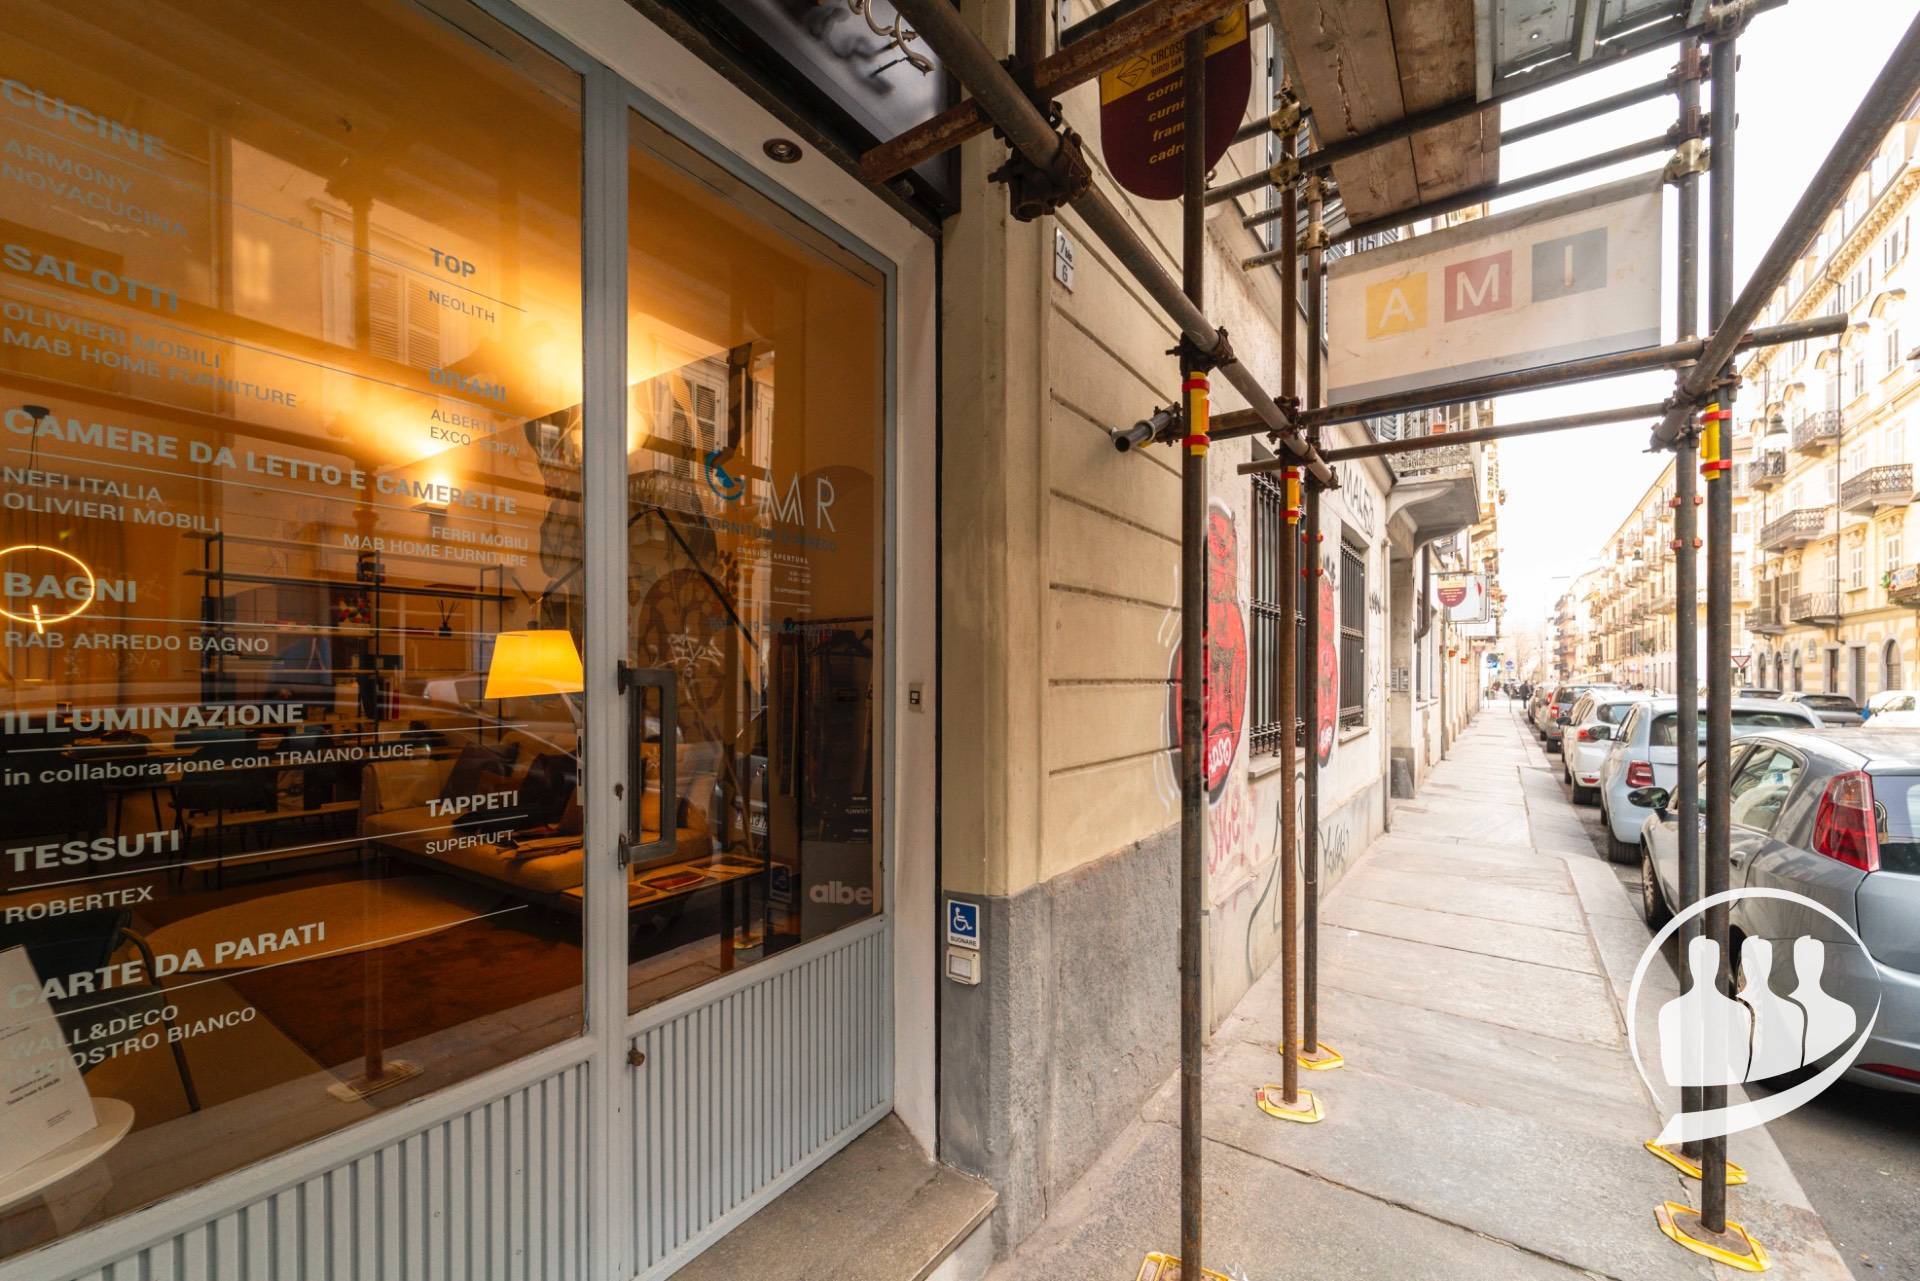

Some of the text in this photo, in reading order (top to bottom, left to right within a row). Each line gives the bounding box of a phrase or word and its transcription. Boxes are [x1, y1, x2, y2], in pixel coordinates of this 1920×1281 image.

[1148, 76, 1184, 101] corni
[3, 79, 166, 161] CUCINE
[1149, 99, 1185, 122] curni
[1152, 122, 1185, 143] fram
[4, 139, 136, 195] ARMONY
[1149, 143, 1185, 165] cadr
[2, 162, 188, 237] NOVACUCINA
[3, 244, 179, 313] SALOTTI
[430, 247, 476, 278] TOP
[429, 290, 495, 323] NEOLITH
[3, 303, 220, 369] OLIVIERI MOBILI
[3, 327, 297, 408] MAB HOME FURNITURE
[4, 408, 517, 515] CAMERE DA LETTO E CAMERETTE
[2, 466, 163, 503] NEFI ITALIA
[3, 492, 220, 532] OLIVIERI MOBILI
[343, 533, 528, 568] MAB HOME FURNITURE
[432, 526, 529, 550] FERRI MOBILI
[3, 572, 137, 603] BAGNI
[5, 631, 269, 653] RAB ARREDO BAGNO
[4, 704, 304, 735] ILLUMINAZIONE
[5, 744, 414, 786] in collaborazione con TRAIANO LUCE
[426, 790, 518, 818] TAPPETI
[6, 829, 180, 872] TESSUTI
[425, 828, 514, 855] SUPERTUFT
[5, 886, 154, 924] ROBERTEX
[8, 921, 326, 1009] CARTE DA PARATI
[167, 1007, 256, 1043] BIANCO
